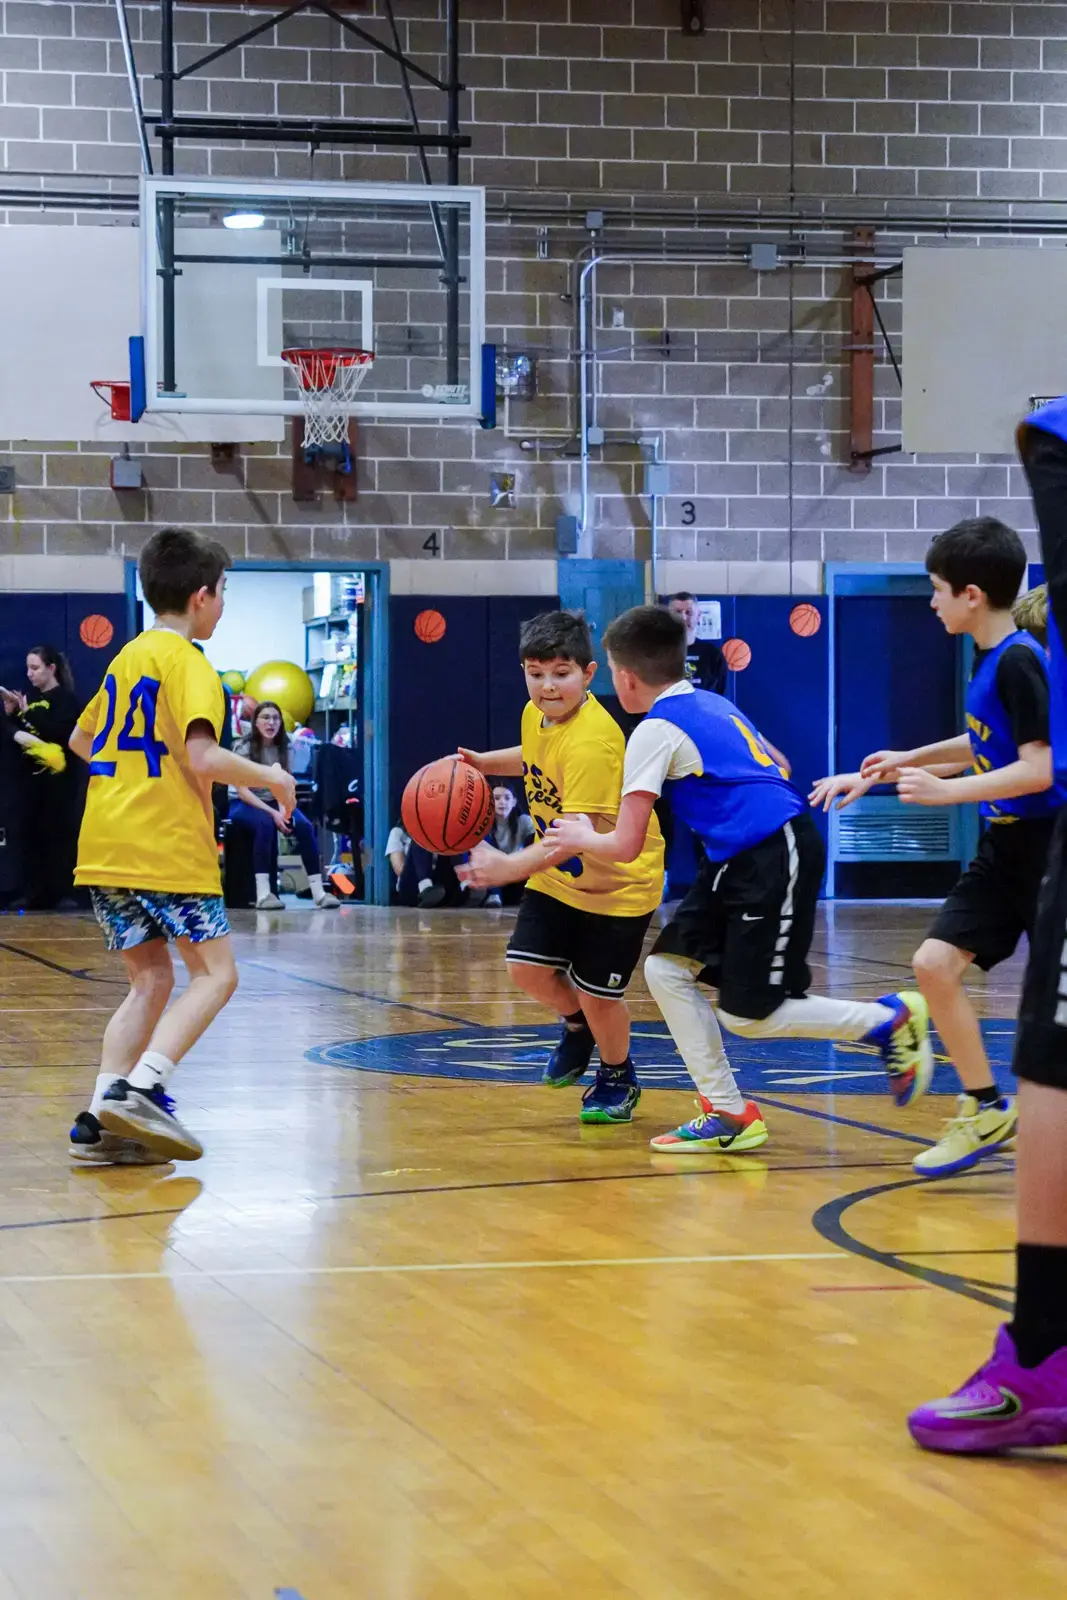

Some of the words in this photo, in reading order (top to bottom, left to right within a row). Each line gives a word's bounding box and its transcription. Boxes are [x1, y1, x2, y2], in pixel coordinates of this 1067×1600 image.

[681, 501, 696, 525] 3
[422, 532, 440, 556] 4
[89, 673, 169, 778] 24
